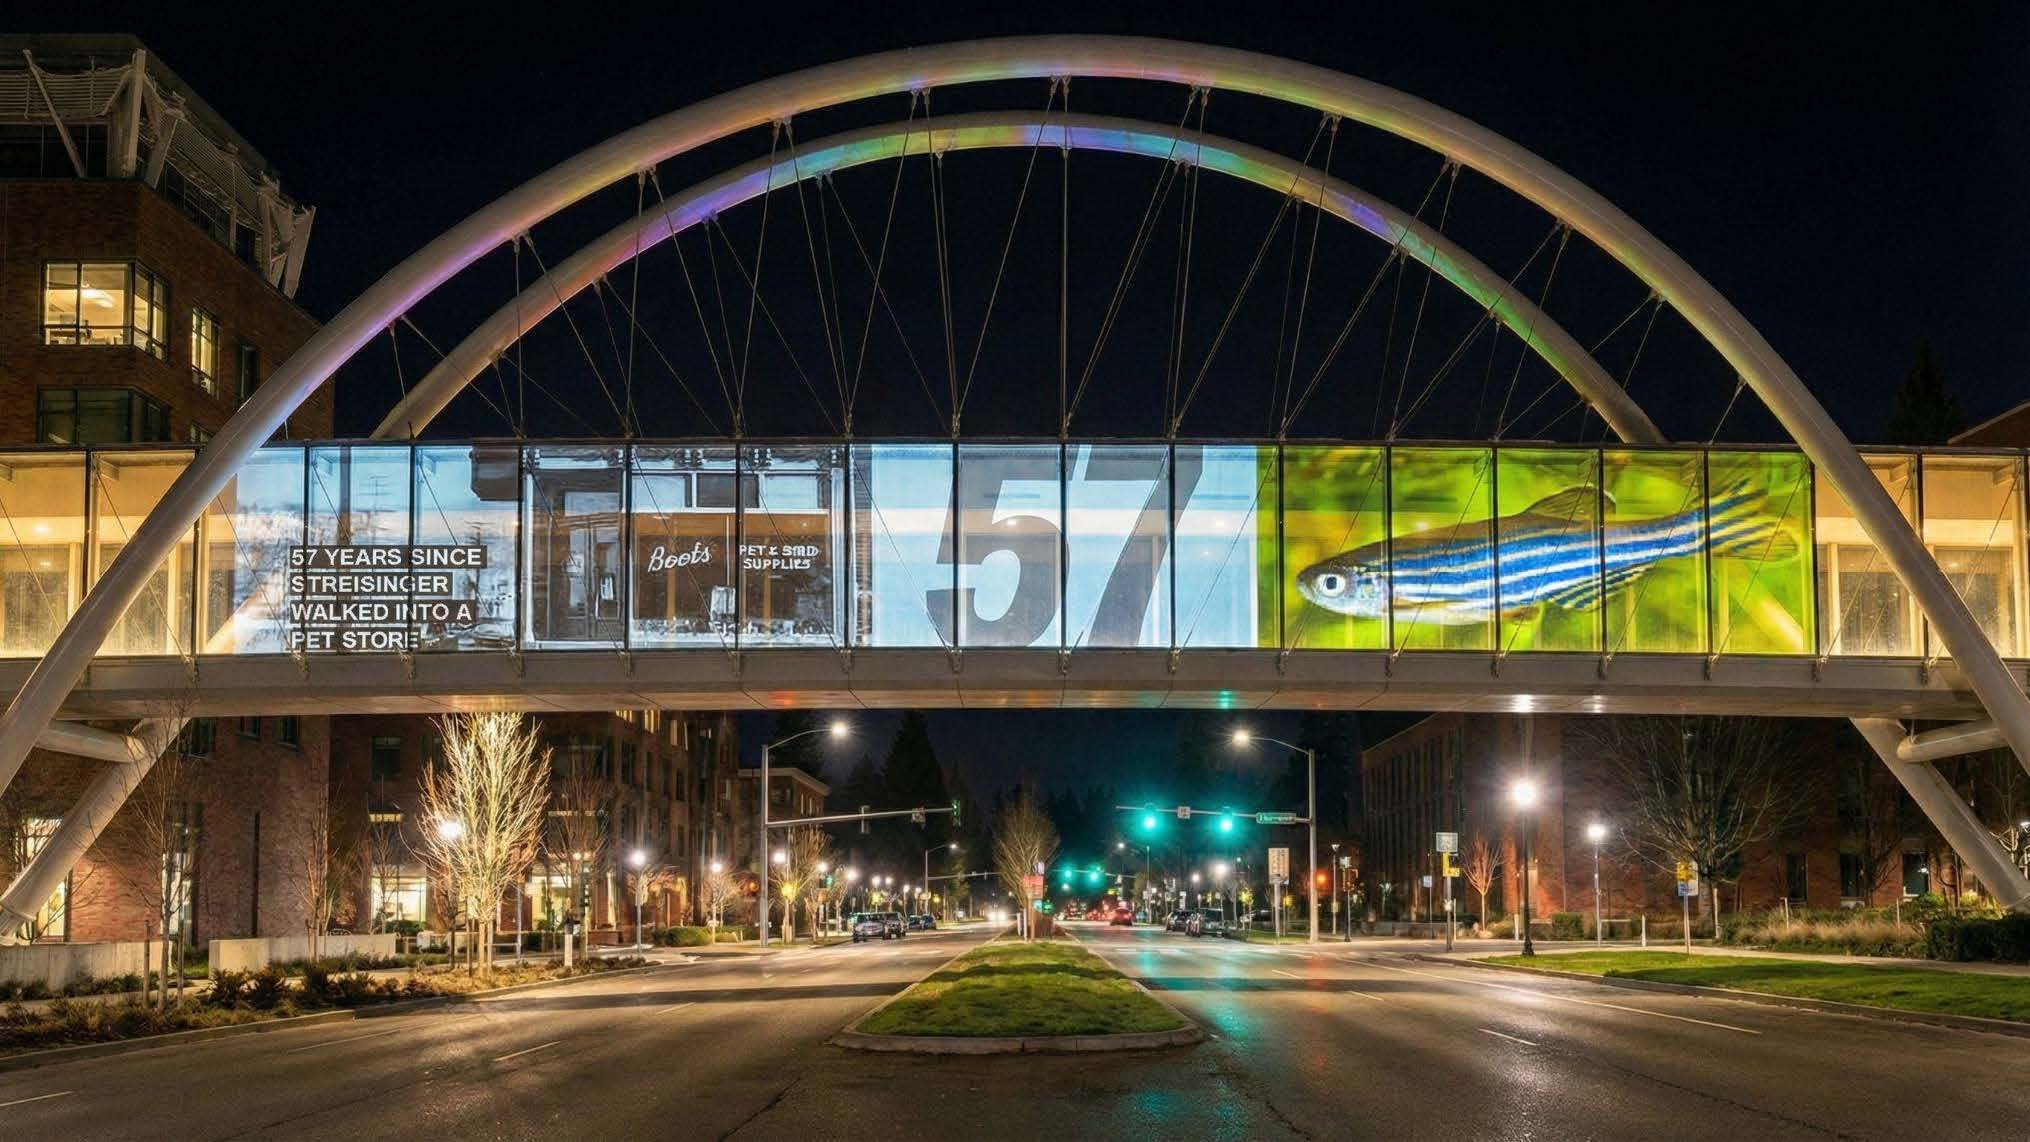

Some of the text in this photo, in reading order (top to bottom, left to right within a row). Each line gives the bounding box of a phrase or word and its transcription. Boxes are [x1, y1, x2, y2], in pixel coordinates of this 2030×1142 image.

[739, 545, 766, 556] PET
[926, 444, 1203, 647] 57
[291, 549, 481, 566] 57 YEARS SINCE
[291, 575, 449, 593] STREISINGER
[291, 603, 472, 621] WALKED INTO A
[291, 631, 419, 649] PET STORE
